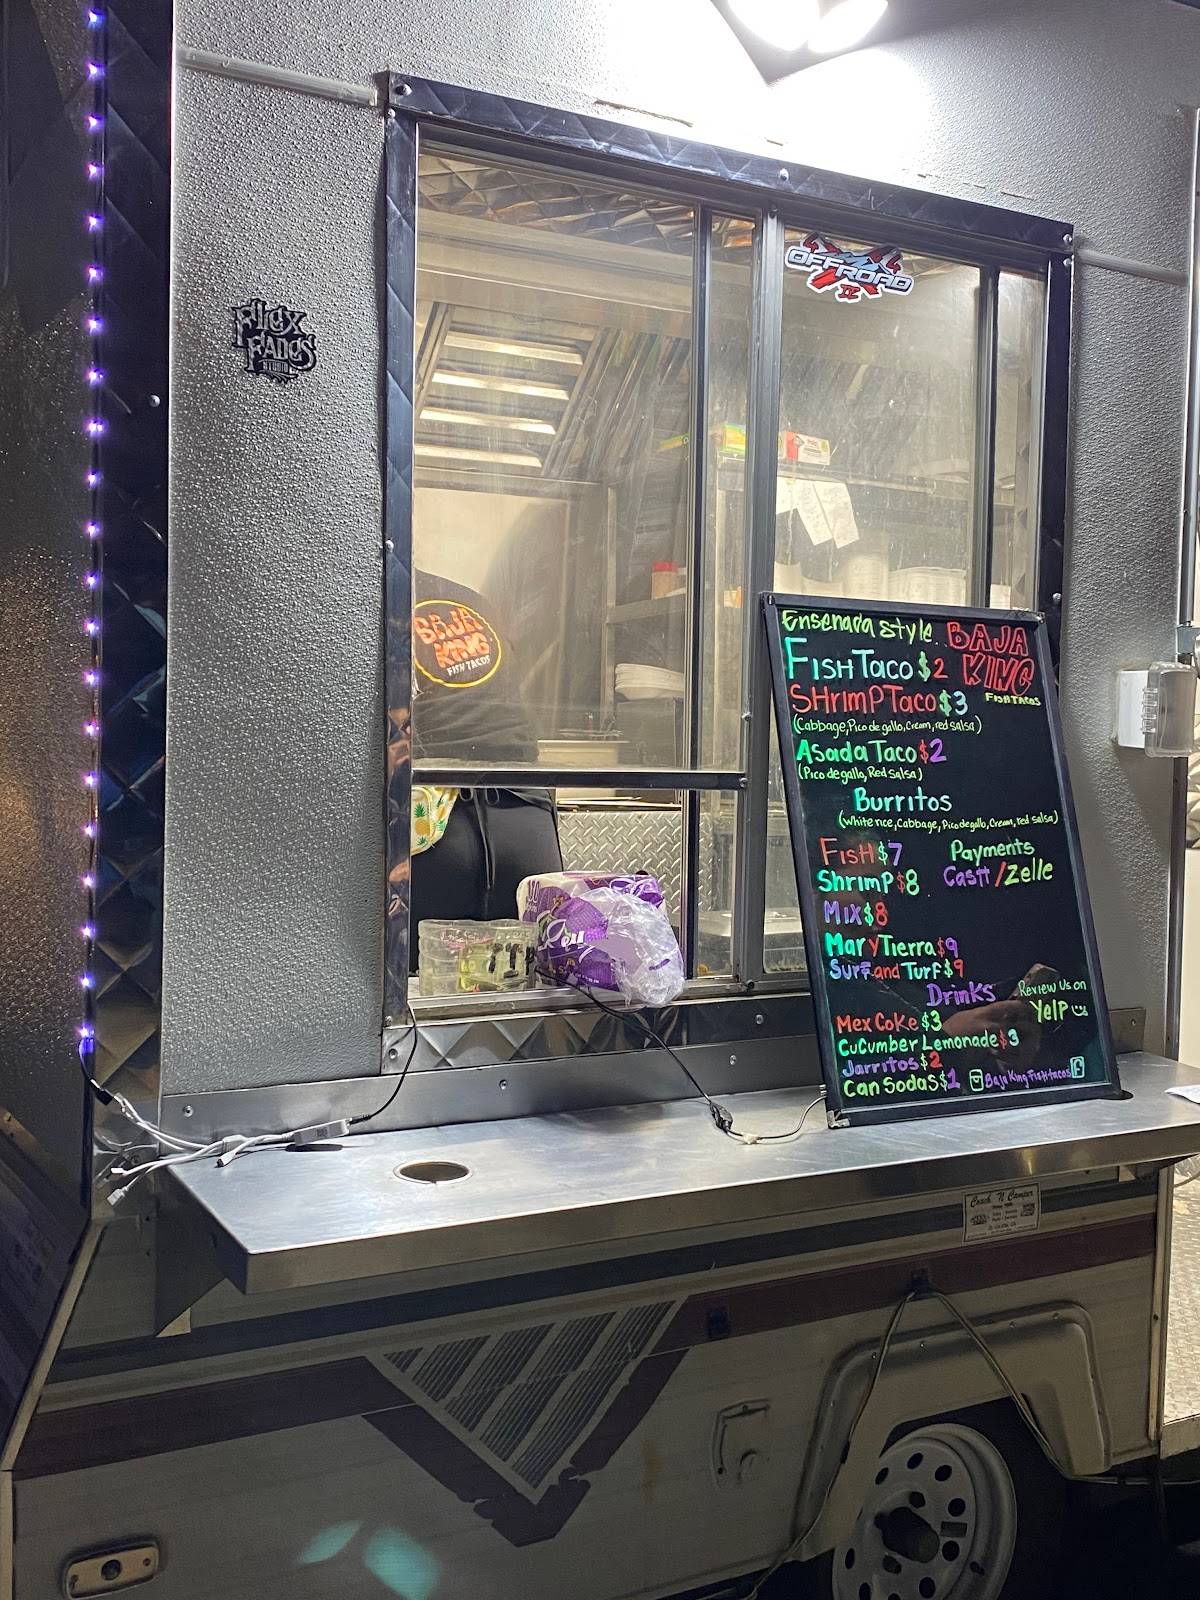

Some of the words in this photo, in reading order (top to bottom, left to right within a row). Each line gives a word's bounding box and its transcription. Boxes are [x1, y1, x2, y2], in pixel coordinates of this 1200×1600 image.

[782, 610, 876, 638] Ensenada
[946, 621, 1029, 657] BAJA
[446, 662, 466, 677] FISH
[466, 655, 491, 671] TACOS
[851, 649, 914, 680] Taco
[918, 651, 949, 682] $2
[962, 651, 1035, 697] KING
[882, 684, 937, 713] Taco
[938, 689, 969, 717] $3
[985, 692, 1011, 704] FISH
[1010, 695, 1042, 707] TACOS
[848, 718, 868, 732] Pico
[868, 719, 881, 732] de
[935, 718, 949, 730] red
[796, 738, 869, 765] Asada
[867, 740, 918, 764] Taco
[919, 737, 948, 765] $2
[826, 767, 838, 780] de
[868, 766, 888, 779] Red
[853, 786, 953, 813] Burritos
[942, 819, 959, 831] Pico
[1016, 812, 1031, 826] red
[877, 840, 903, 867] $7
[950, 838, 1036, 867] Payments
[896, 868, 921, 896] $8
[823, 900, 863, 926] Mix
[863, 901, 889, 927] $8
[824, 932, 867, 957] Mar
[877, 934, 937, 957] Tierra
[937, 936, 960, 959] $9
[829, 958, 872, 980] Surf
[872, 962, 900, 980] and
[900, 961, 942, 980] Turf
[943, 958, 965, 979] $9
[1018, 979, 1057, 997] Review
[1059, 978, 1072, 991] Us
[1073, 980, 1087, 991] on
[836, 1015, 873, 1034] Mex
[874, 1012, 920, 1032] Coke
[921, 1009, 943, 1032] $3
[921, 1028, 1000, 1052] Lemonade
[999, 1028, 1020, 1050] $3
[842, 1056, 920, 1078] Jarritos
[920, 1050, 943, 1071] $2
[843, 1078, 880, 1097] Can
[939, 1067, 961, 1092] $1
